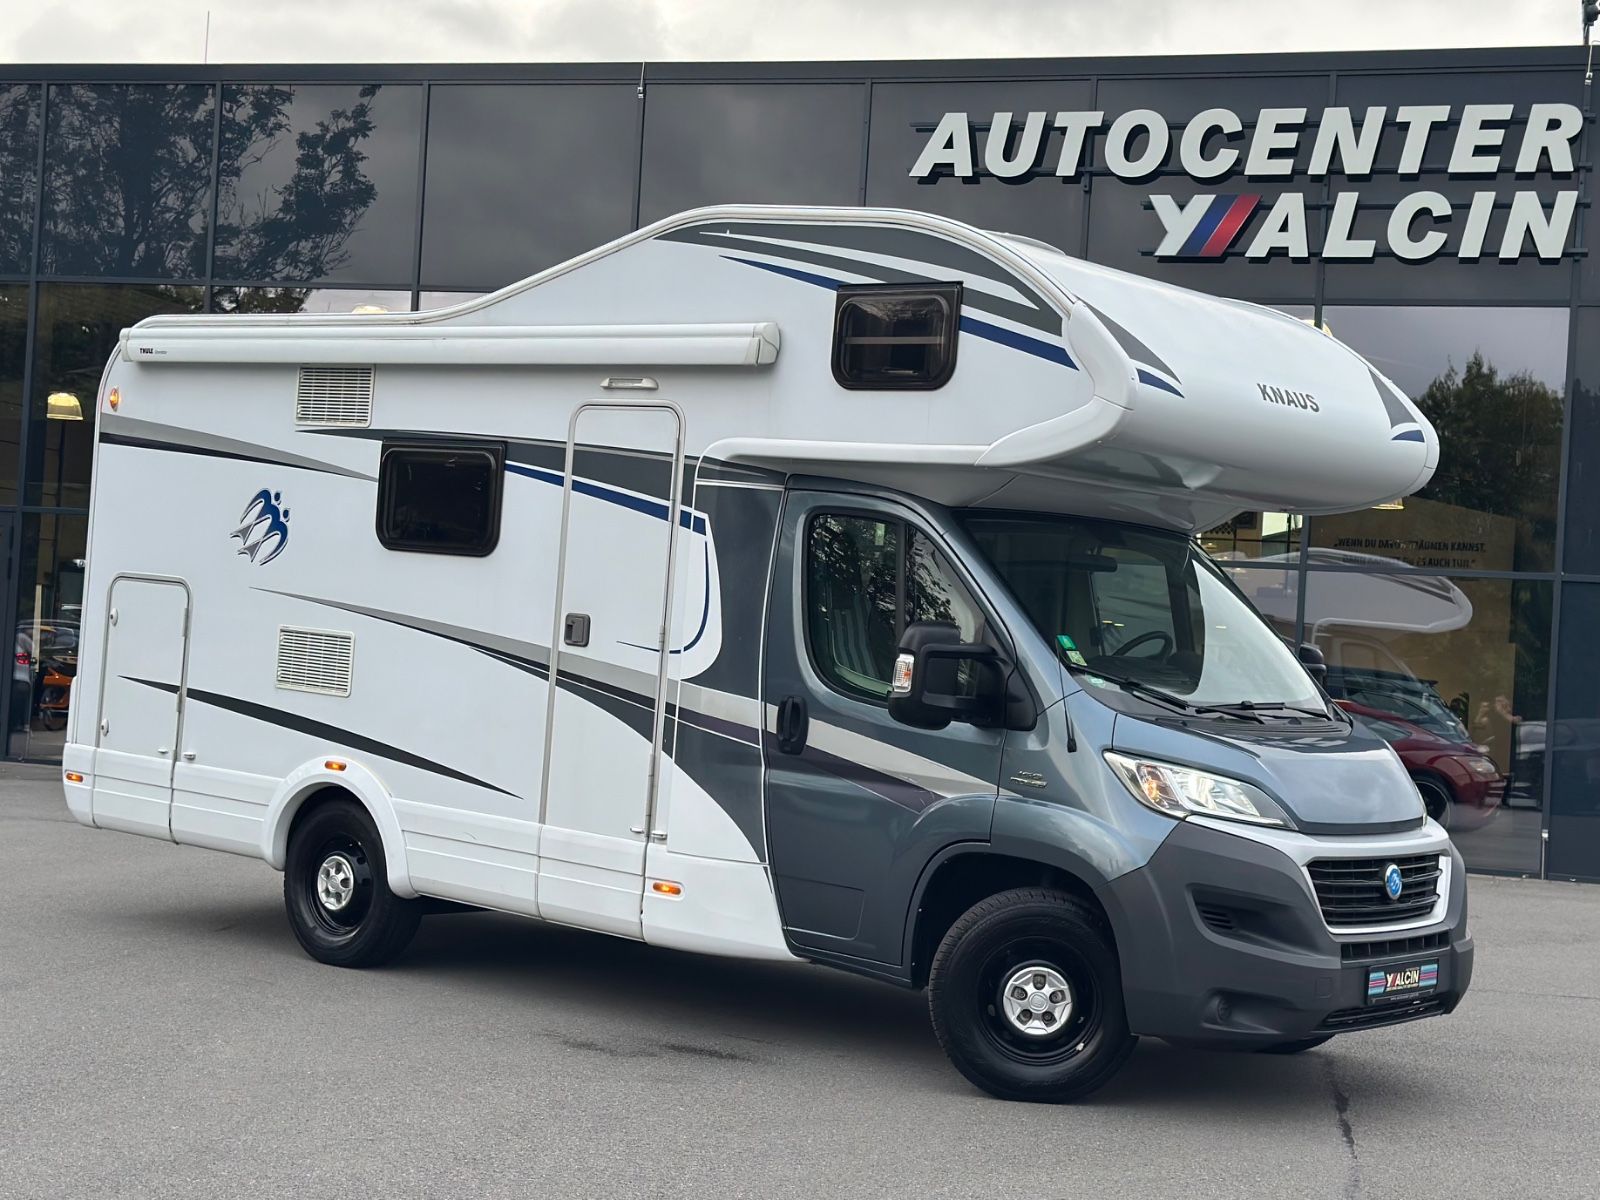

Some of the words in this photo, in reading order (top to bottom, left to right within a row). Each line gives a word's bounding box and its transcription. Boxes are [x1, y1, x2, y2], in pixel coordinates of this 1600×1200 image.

[908, 103, 1584, 178] AUTOCENTER
[1256, 383, 1320, 413] KNAUS
[1364, 538, 1377, 548] DU
